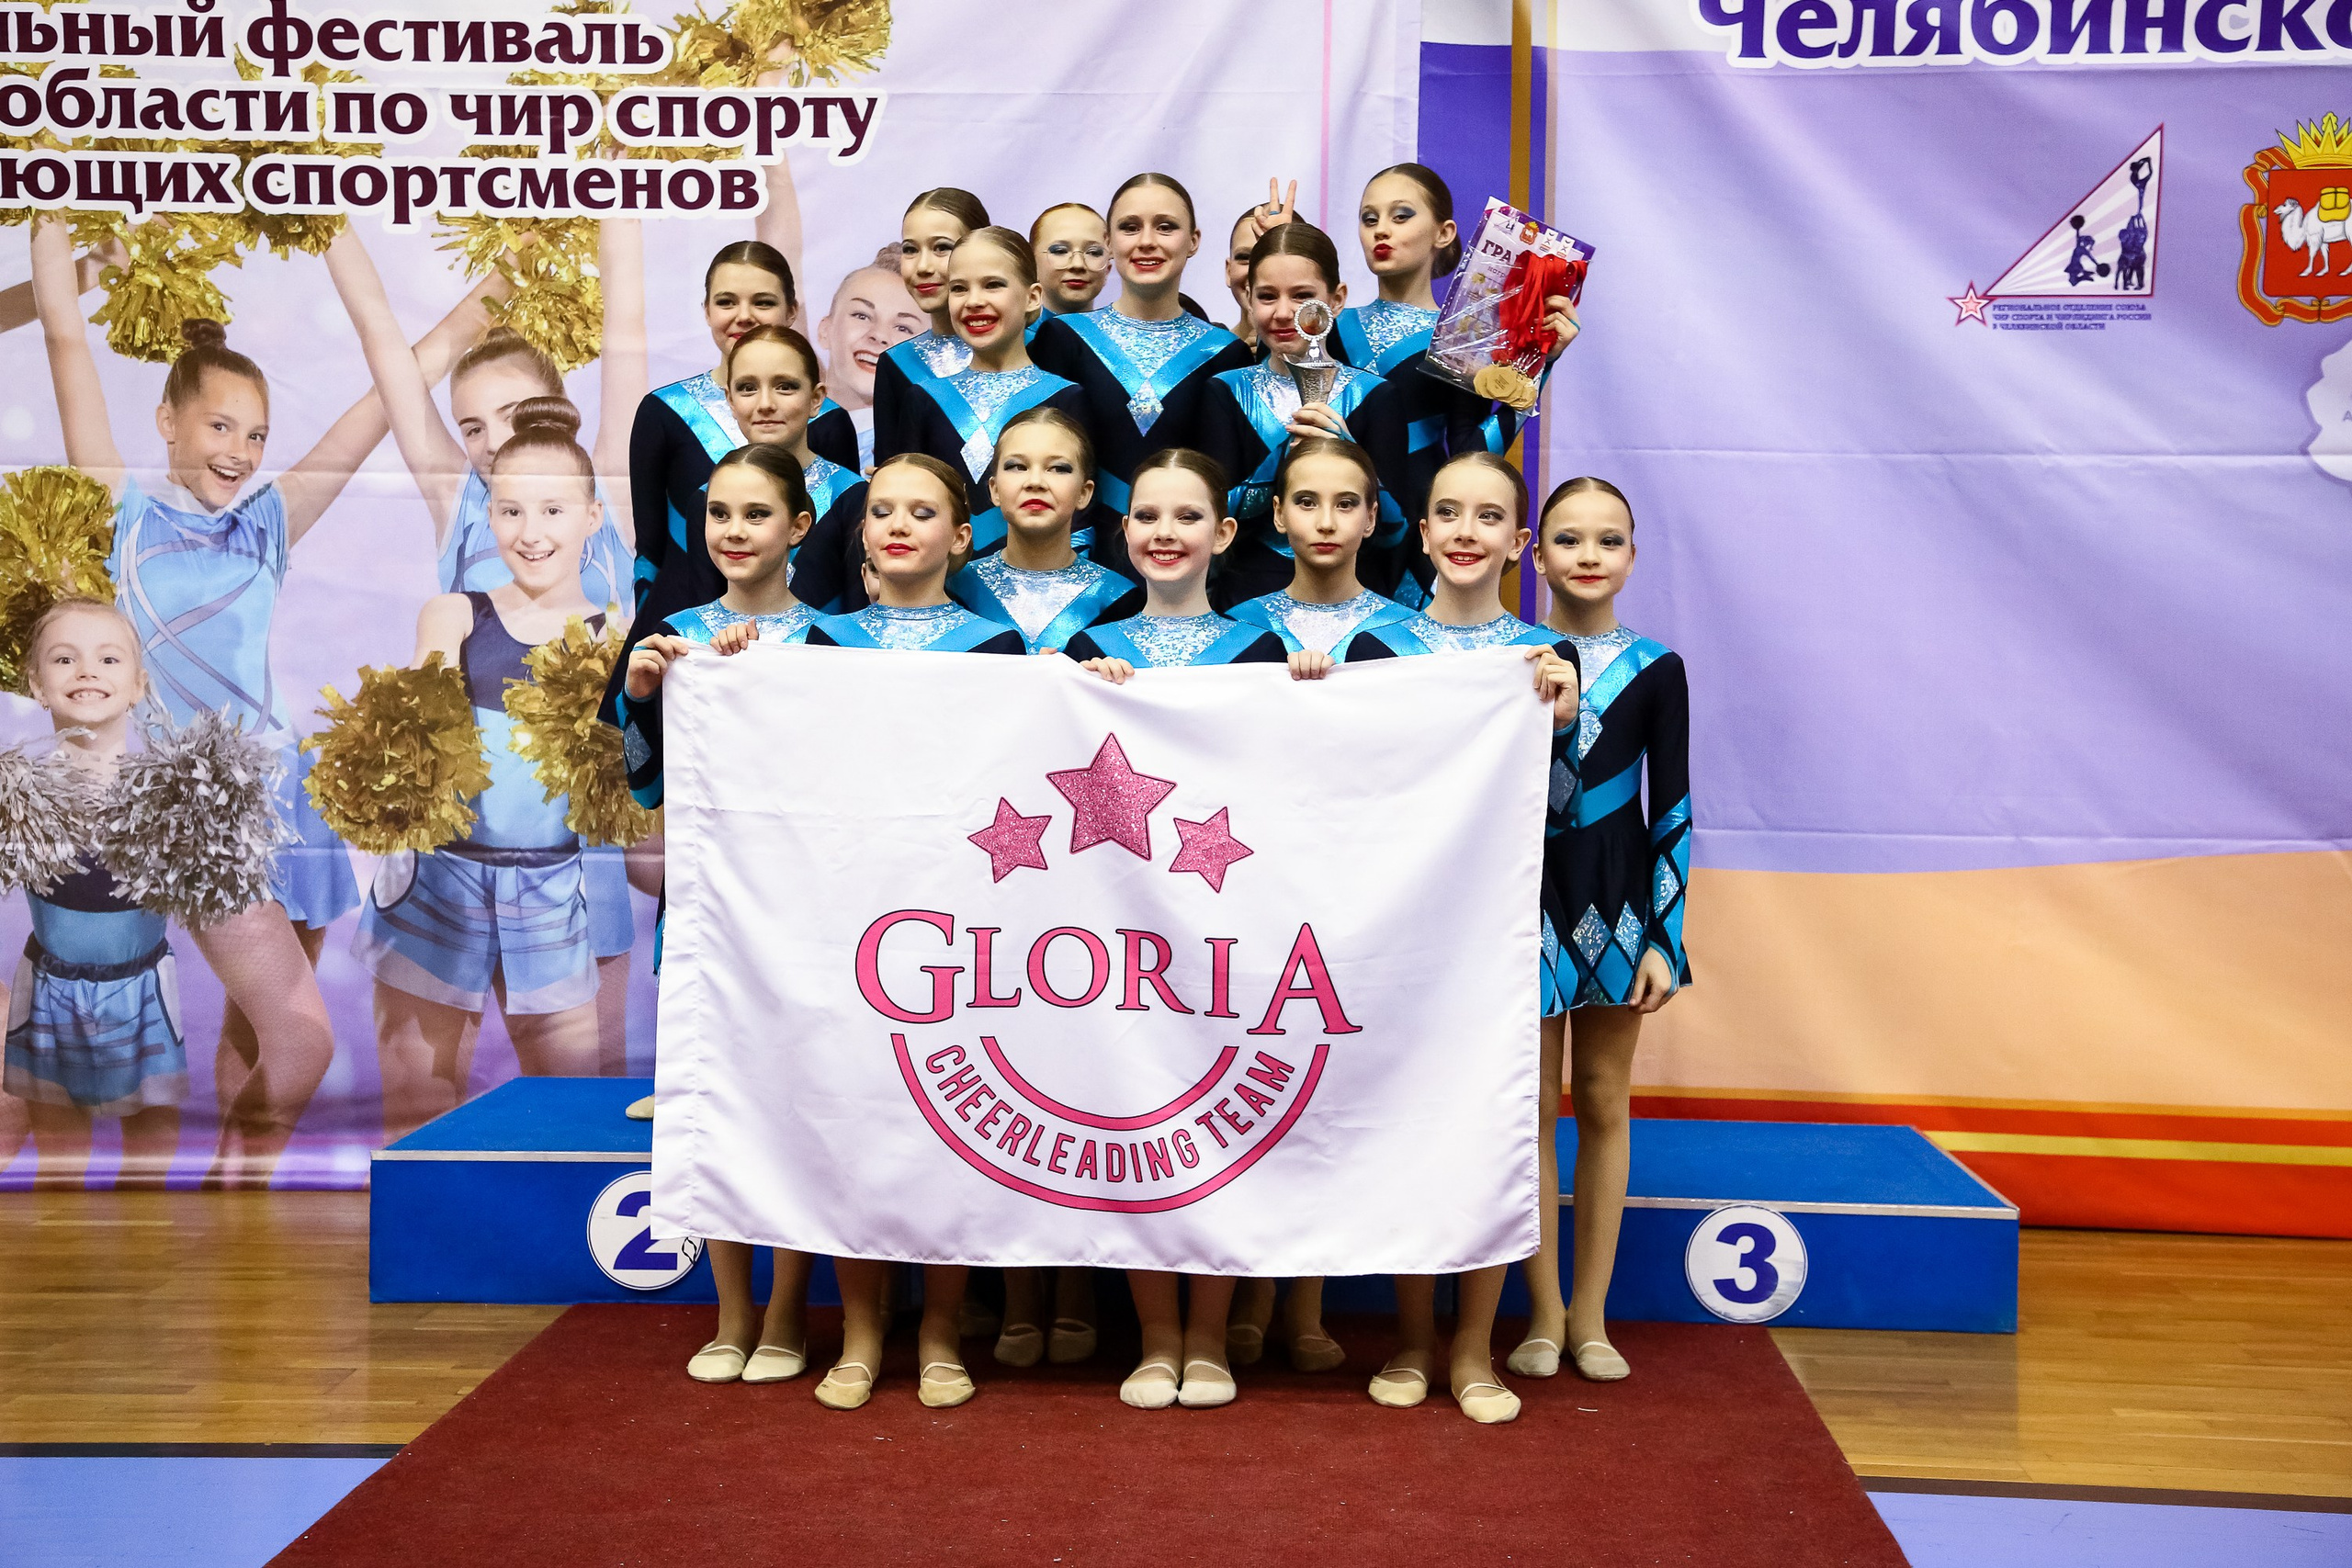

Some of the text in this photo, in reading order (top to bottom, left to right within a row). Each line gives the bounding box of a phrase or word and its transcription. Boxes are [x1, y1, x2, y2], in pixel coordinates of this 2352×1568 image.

[0, 0, 663, 76] ьный фестиваль
[0, 68, 876, 157] области по чир спорту
[252, 164, 759, 224] спортсменов
[1481, 239, 1521, 266] ГРА
[854, 908, 1363, 1035] GLORIA
[925, 1044, 1296, 1184] CHEERLEADING TEAM
[613, 1190, 678, 1270] 2
[1713, 1222, 1779, 1304] 3
